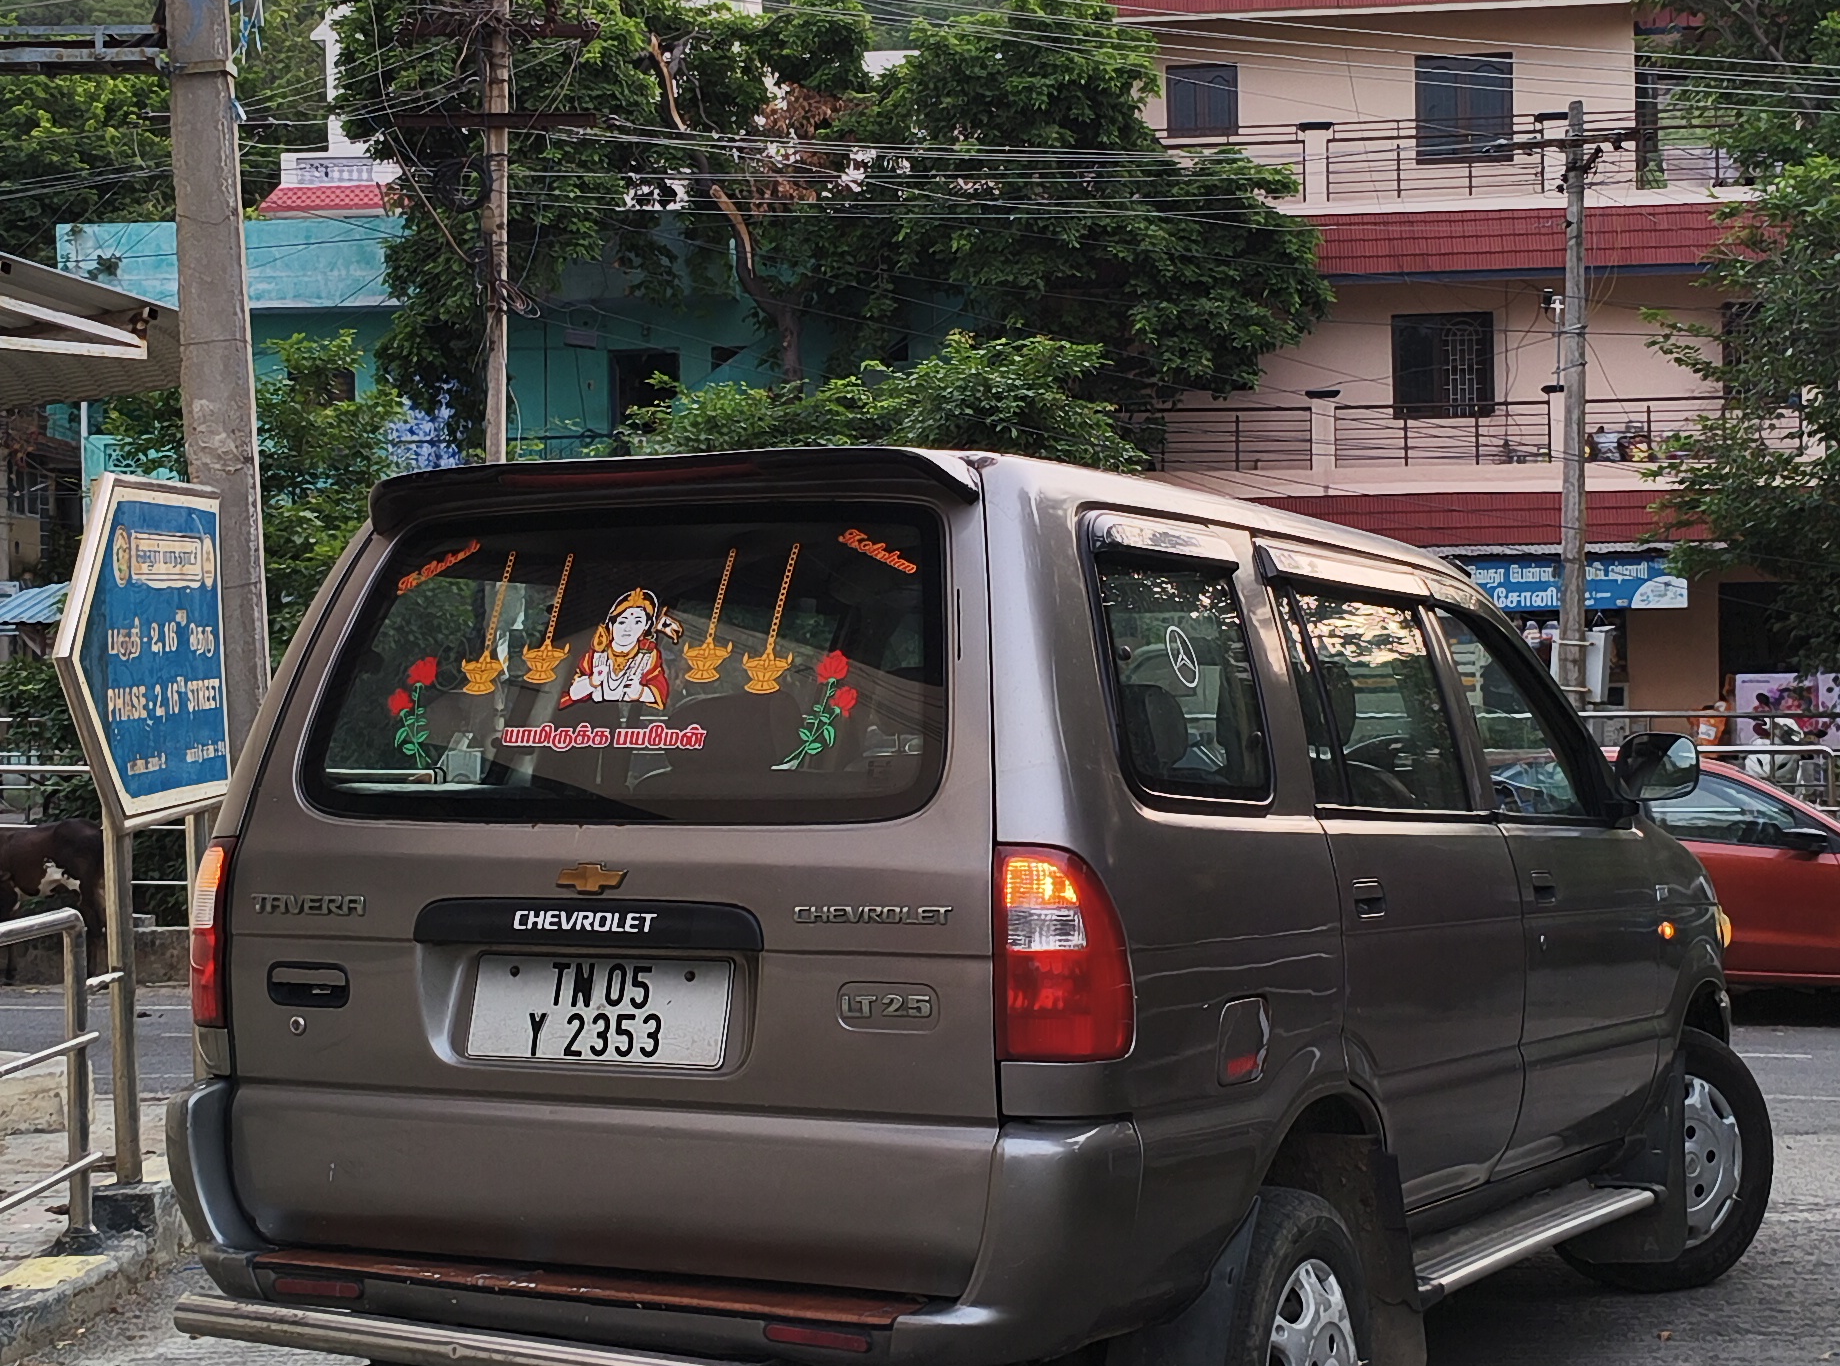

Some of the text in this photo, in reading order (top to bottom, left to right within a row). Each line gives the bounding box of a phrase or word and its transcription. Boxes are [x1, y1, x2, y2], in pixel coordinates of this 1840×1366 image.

[107, 616, 141, 662] பகுதி
[189, 622, 215, 658] தெரு
[107, 685, 148, 723] PHASE
[187, 678, 220, 714] STREET
[502, 722, 708, 752] யாமிருக்க பயமேன்
[251, 893, 367, 917] TAVERA
[793, 904, 954, 926] CHEVROLET
[513, 910, 657, 933] CHEVROLET
[552, 962, 653, 1010] TN 05
[841, 994, 877, 1019] LT
[529, 1012, 663, 1059] Y 2353
